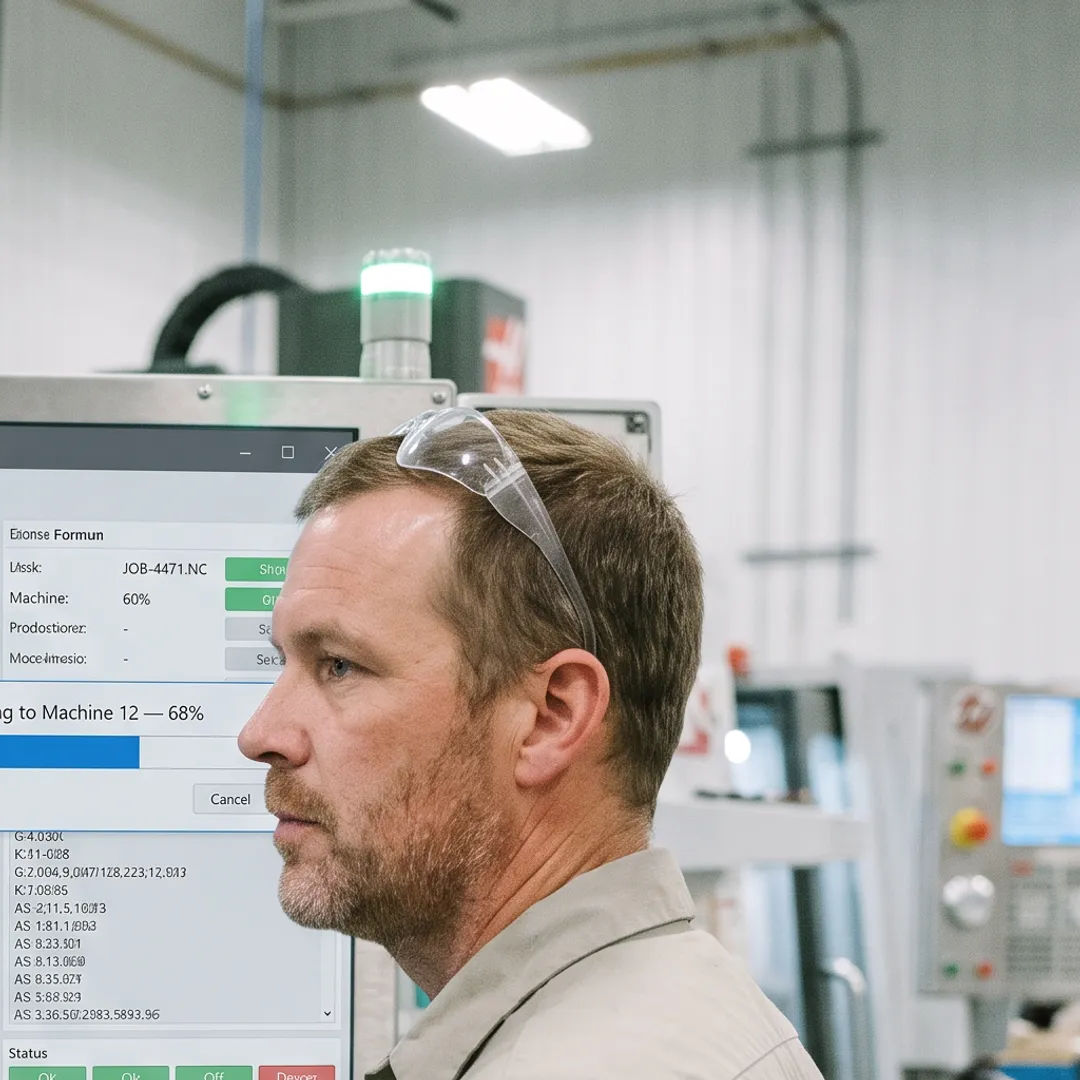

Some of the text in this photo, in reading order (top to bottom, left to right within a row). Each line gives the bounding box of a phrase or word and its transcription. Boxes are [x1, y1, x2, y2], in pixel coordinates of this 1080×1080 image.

[54, 528, 104, 541] Formun
[122, 562, 207, 576] JOB-4471.NC
[9, 591, 151, 606] Machine: 60%
[18, 705, 37, 720] to
[42, 703, 114, 721] Machine
[119, 704, 139, 721] 12
[168, 705, 205, 721] 68%
[210, 793, 251, 806] Cancel
[8, 1047, 48, 1059] Status
